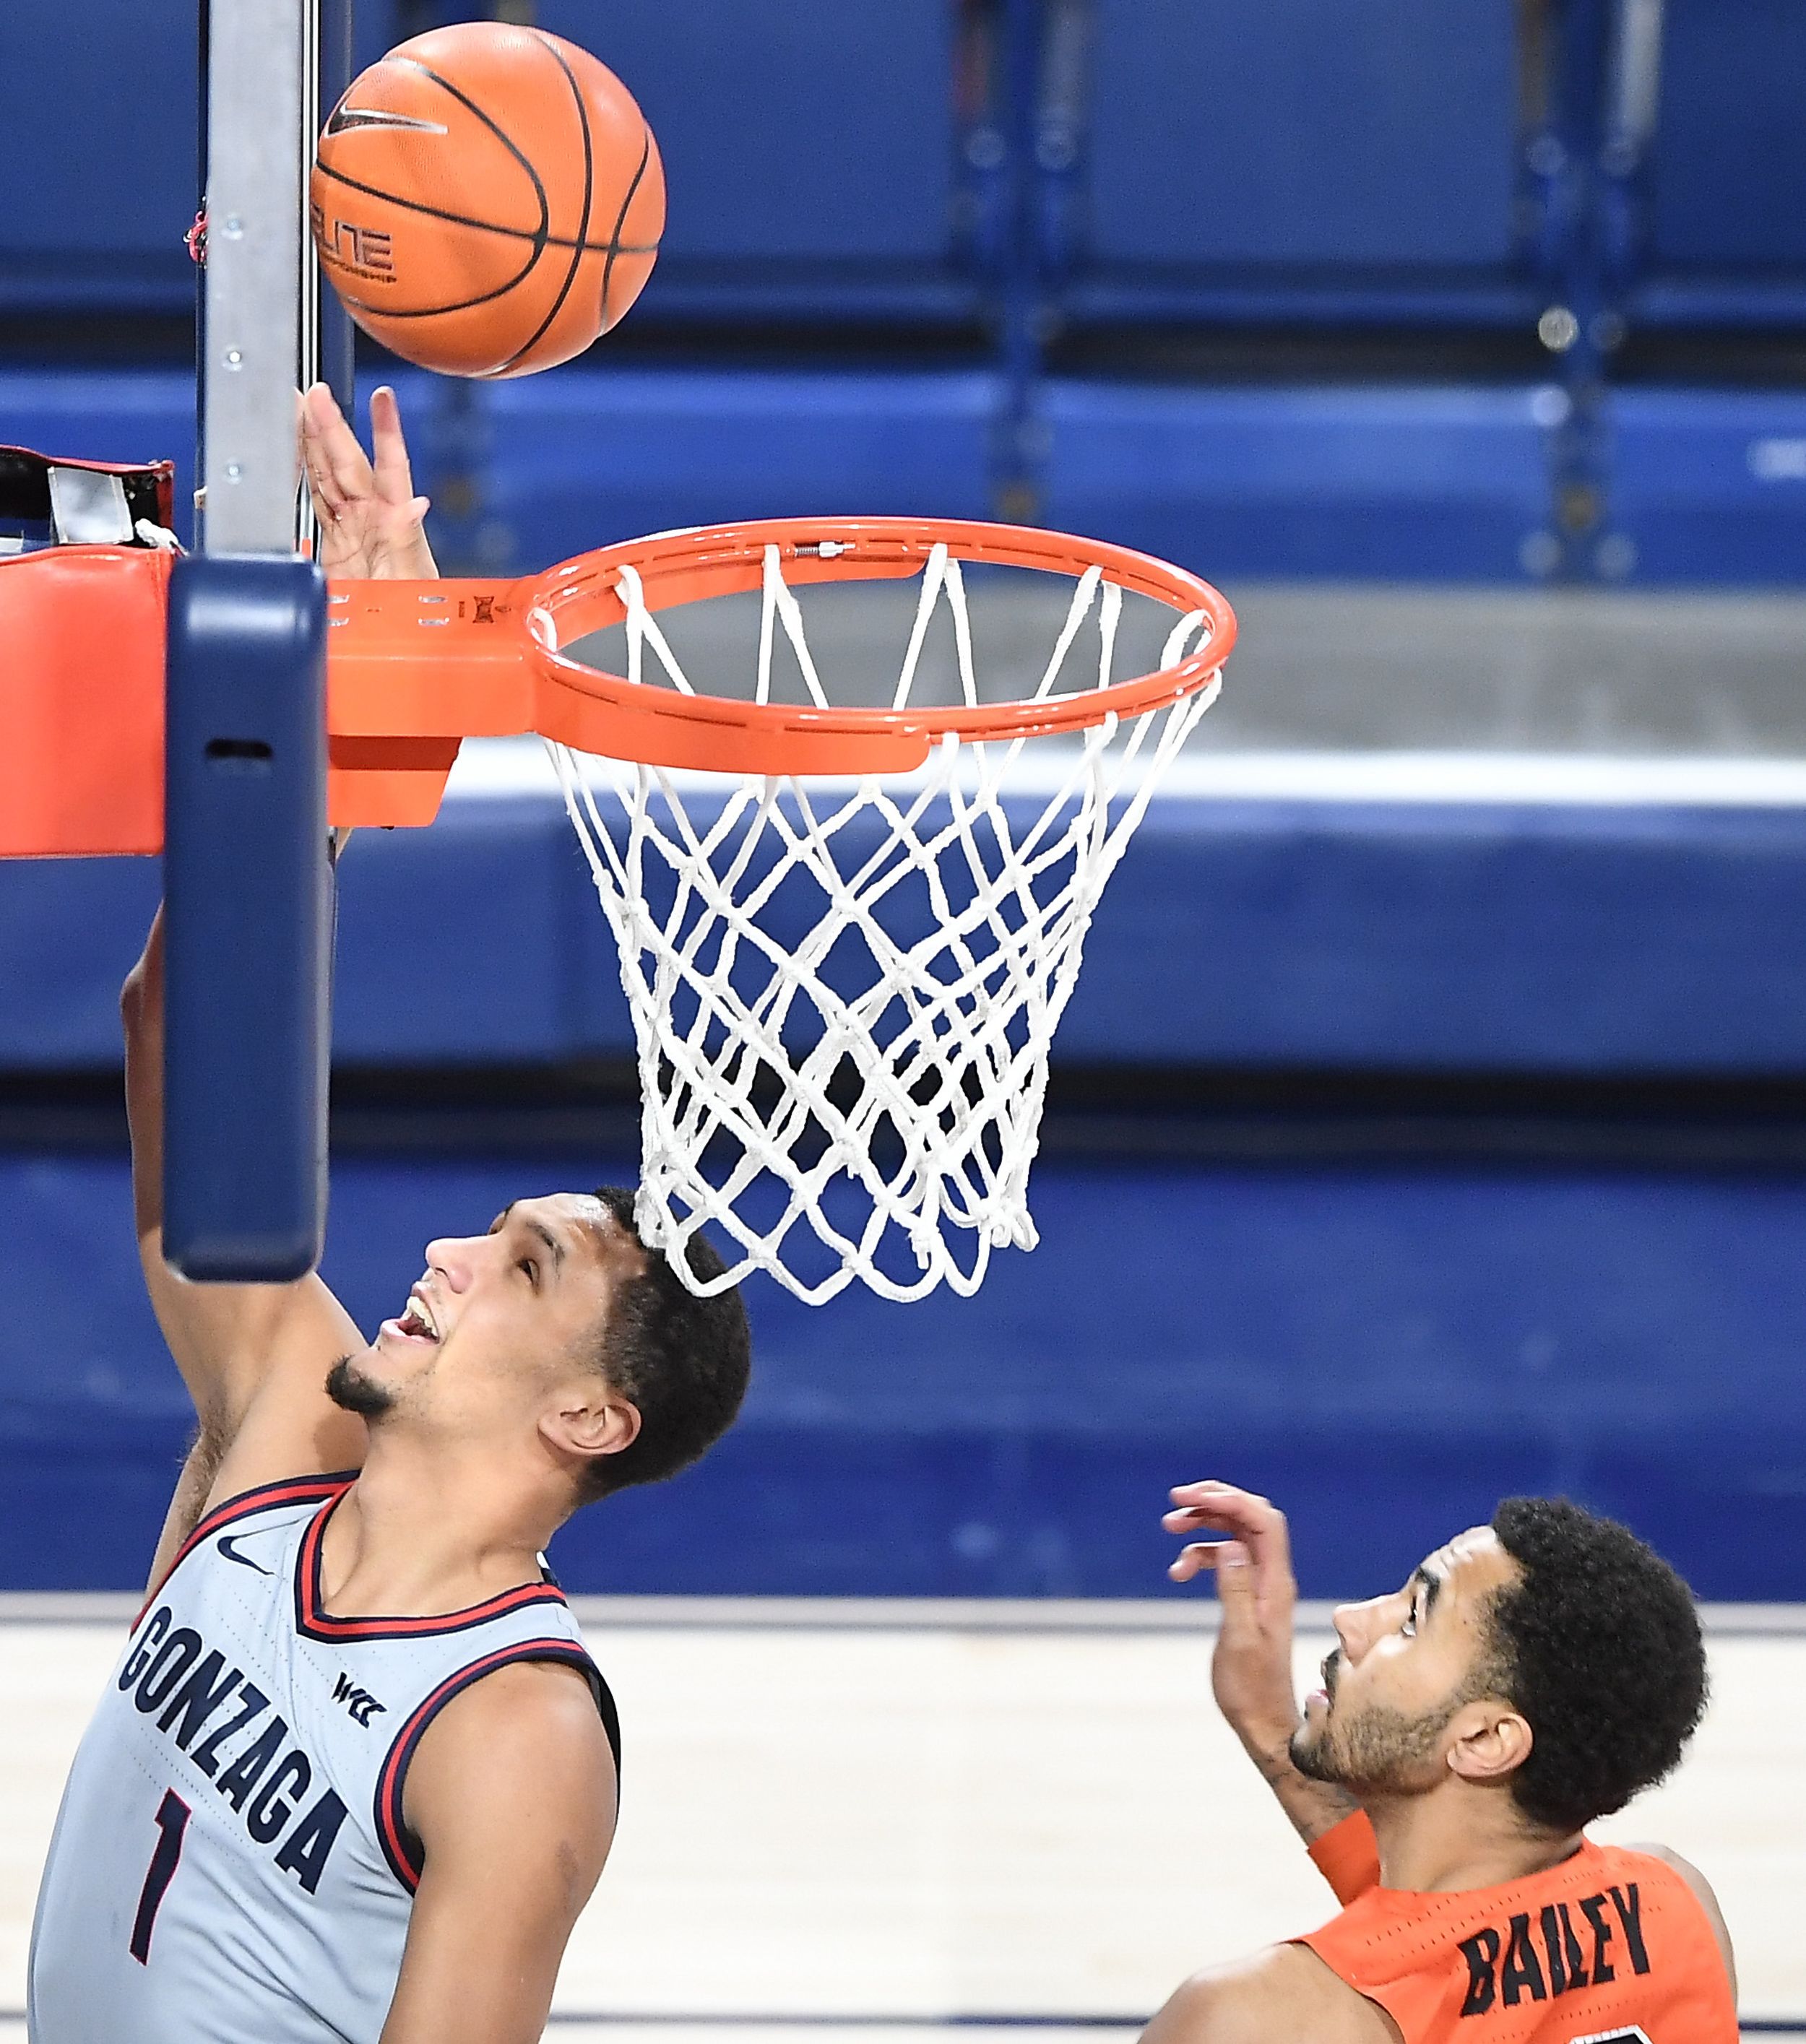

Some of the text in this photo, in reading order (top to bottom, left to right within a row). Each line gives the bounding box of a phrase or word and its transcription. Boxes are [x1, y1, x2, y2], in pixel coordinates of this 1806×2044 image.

[118, 1606, 349, 1895] GONZAGA
[330, 1671, 388, 1730] WCC
[129, 1786, 193, 1967] 1
[1456, 1881, 1651, 2019] BAILEY
